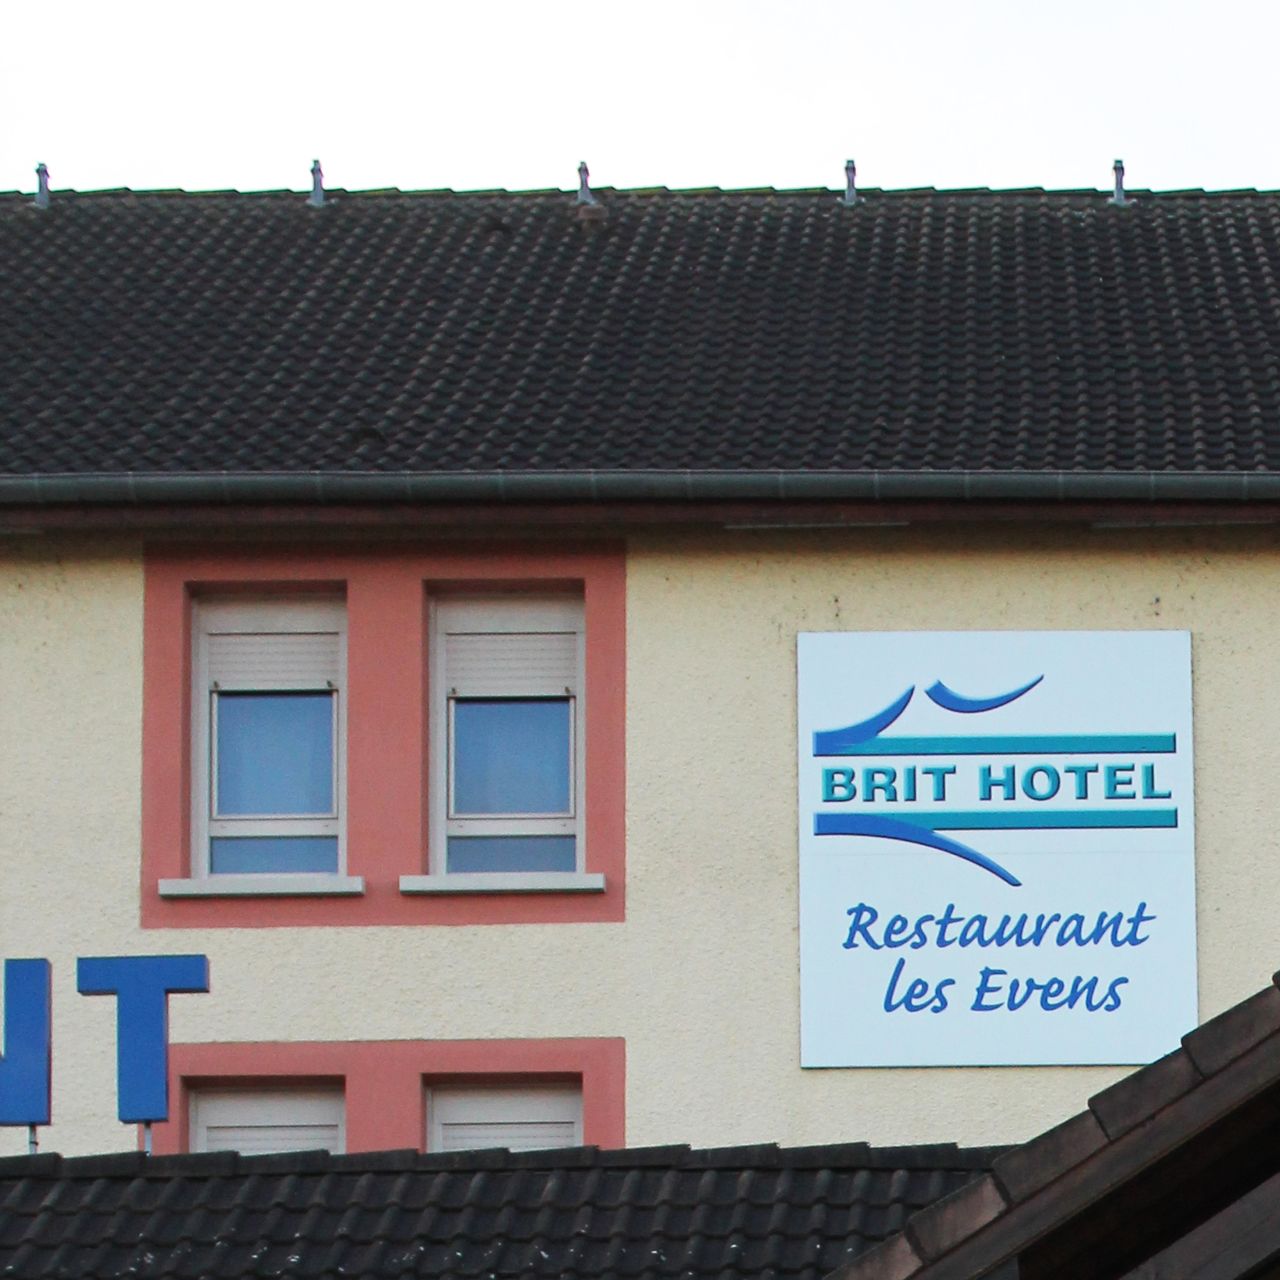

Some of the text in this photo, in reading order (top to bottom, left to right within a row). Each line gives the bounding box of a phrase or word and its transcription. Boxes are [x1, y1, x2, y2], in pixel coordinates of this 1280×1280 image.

[821, 762, 1172, 802] BRIT HOTEL
[842, 901, 1157, 950] Restaurant
[883, 957, 1129, 1013] les Evens
